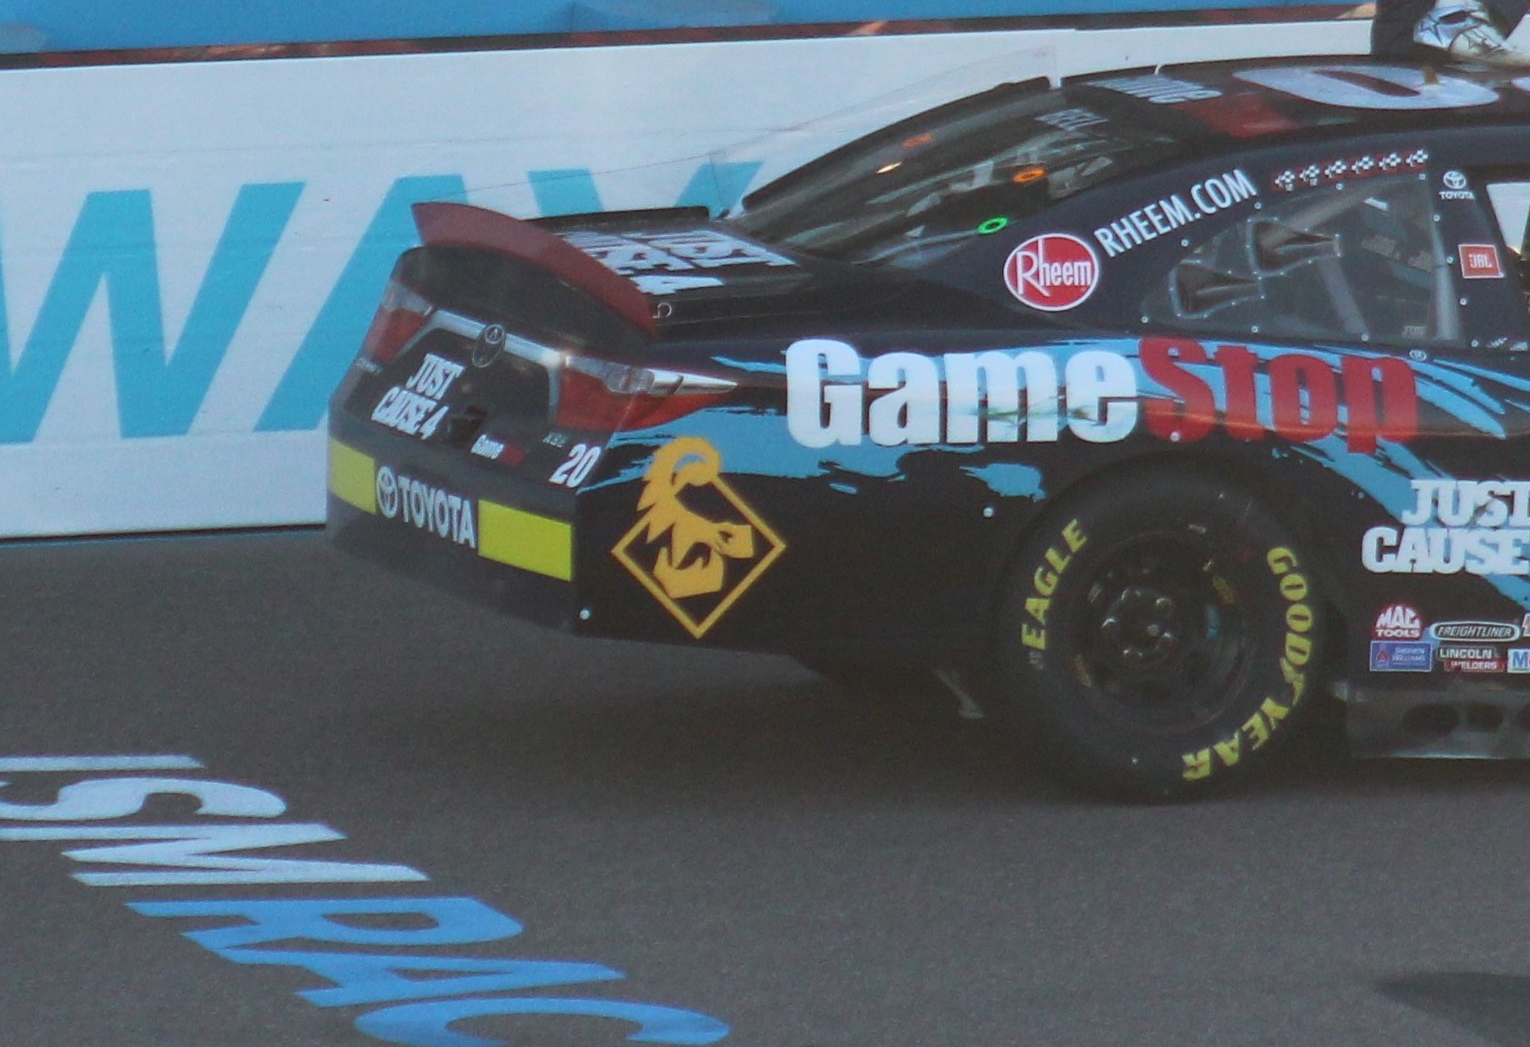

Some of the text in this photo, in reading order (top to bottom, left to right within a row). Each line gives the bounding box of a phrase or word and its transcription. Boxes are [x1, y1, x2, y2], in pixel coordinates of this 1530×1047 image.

[1094, 169, 1257, 258] RHEEM.COM
[1439, 190, 1475, 200] TOYOTA
[1015, 238, 1092, 300] Rheem
[1470, 253, 1492, 269] JBL
[405, 353, 466, 401] JUST
[784, 337, 1419, 455] GameStop
[371, 386, 449, 440] CAUSE 4
[548, 443, 602, 488] 20
[398, 474, 477, 549] TOYOTA
[1361, 526, 1530, 575] CAUSE
[1021, 518, 1088, 650] EAGLE
[1375, 628, 1421, 638] TOOLS
[1376, 605, 1421, 628] MAC
[1437, 624, 1513, 638] FREIGHTLINER
[1439, 647, 1493, 660] LINCOLN
[1450, 660, 1498, 671] WELDERS
